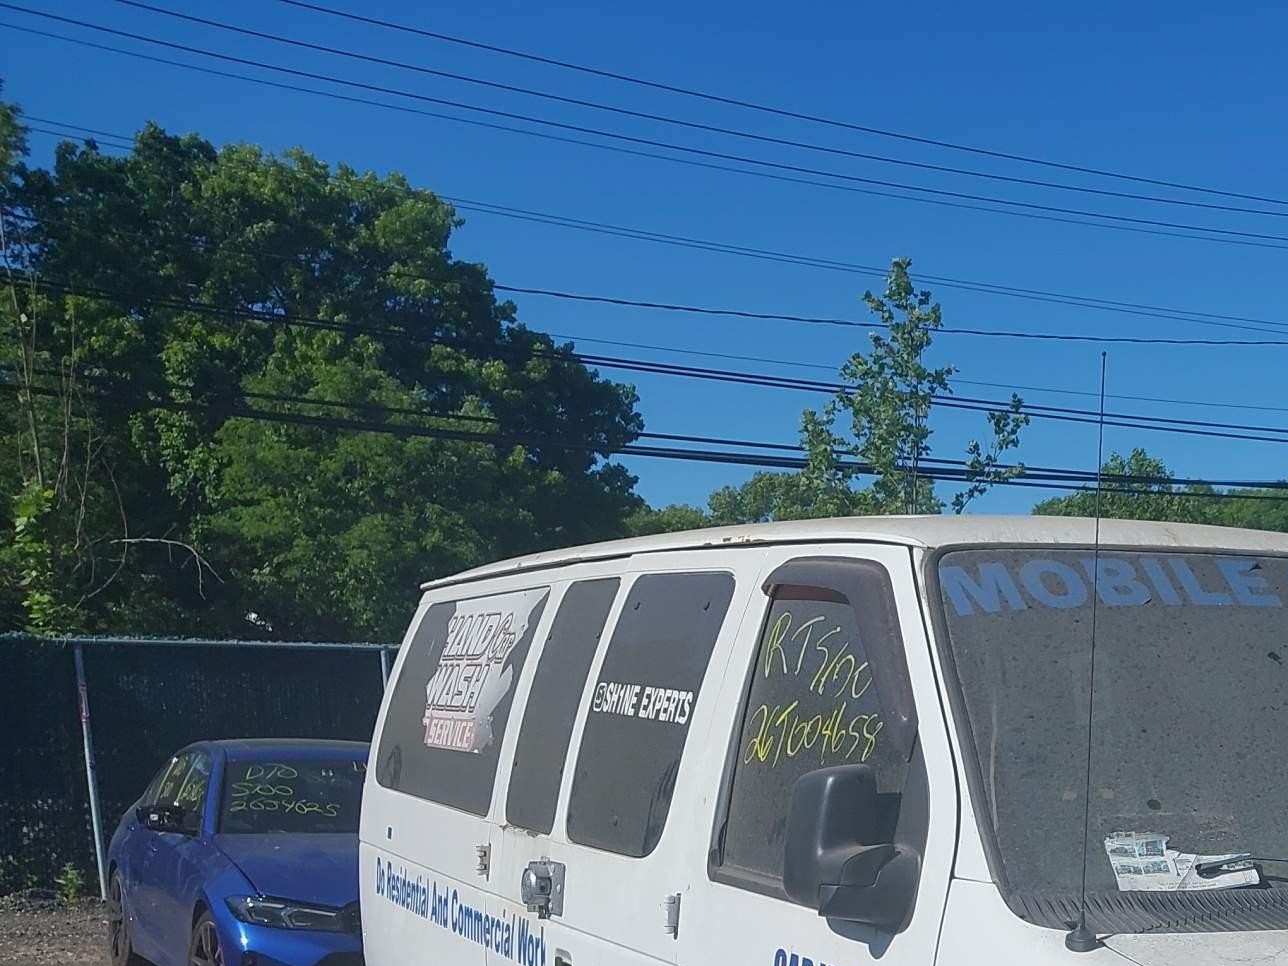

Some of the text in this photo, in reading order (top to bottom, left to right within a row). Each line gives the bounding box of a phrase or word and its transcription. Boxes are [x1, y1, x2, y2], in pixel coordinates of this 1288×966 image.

[938, 557, 1282, 617] MOBILE
[428, 664, 491, 711] WASH
[638, 686, 694, 725] EXPERTS
[428, 718, 473, 747] SERVICE
[376, 856, 385, 896] Do
[386, 861, 430, 919] Residential
[430, 880, 449, 928] And
[451, 889, 516, 961] Commercial
